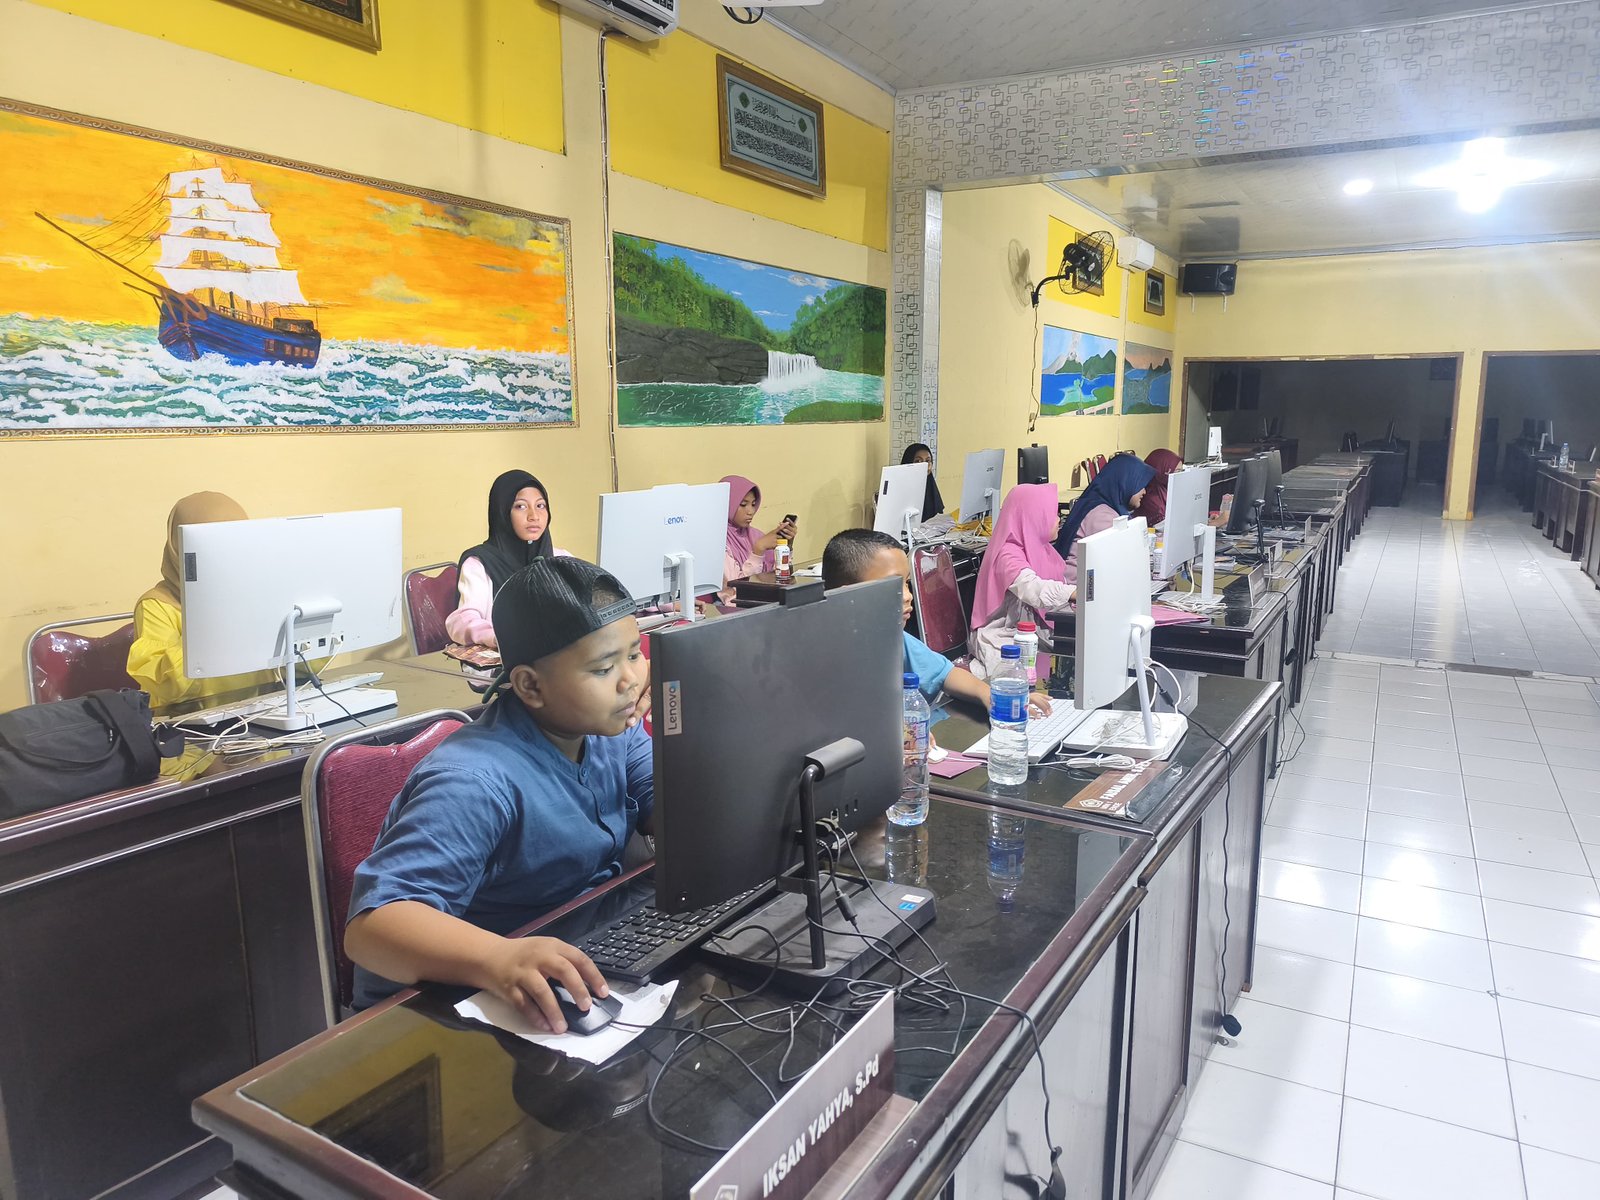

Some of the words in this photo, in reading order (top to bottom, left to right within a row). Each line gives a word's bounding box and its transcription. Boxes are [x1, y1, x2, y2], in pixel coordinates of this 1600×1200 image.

[668, 686, 677, 730] Lenovo
[762, 1132, 807, 1198] IKSAN
[808, 1087, 854, 1146] YAHYA,
[855, 1053, 880, 1095] S.Pd
